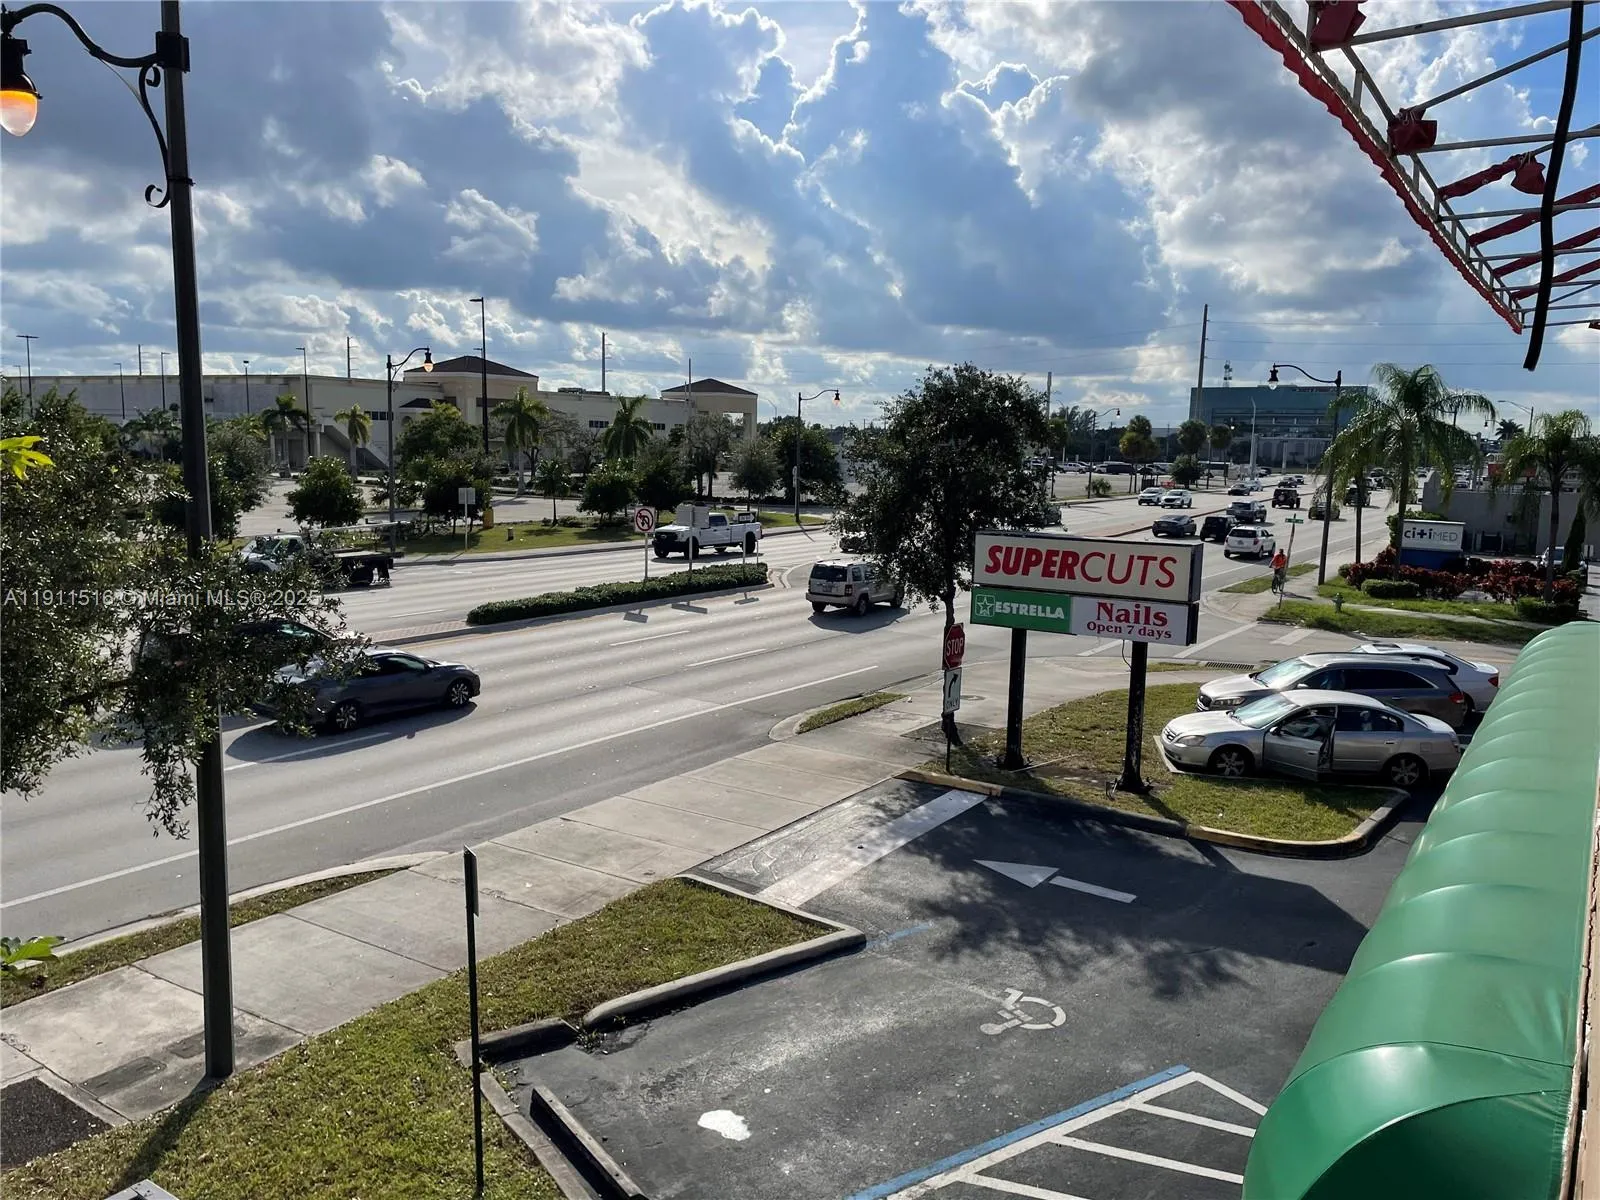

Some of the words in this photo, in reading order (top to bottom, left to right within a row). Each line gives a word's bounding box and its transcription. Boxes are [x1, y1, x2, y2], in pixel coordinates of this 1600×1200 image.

[984, 545, 1178, 589] SUPERCUTS
[995, 600, 1065, 620] ESTRELLA
[1096, 601, 1168, 627] Nails
[1086, 621, 1122, 635] Open
[1127, 625, 1134, 635] 7
[1137, 626, 1172, 639] days
[946, 637, 964, 657] STOP
